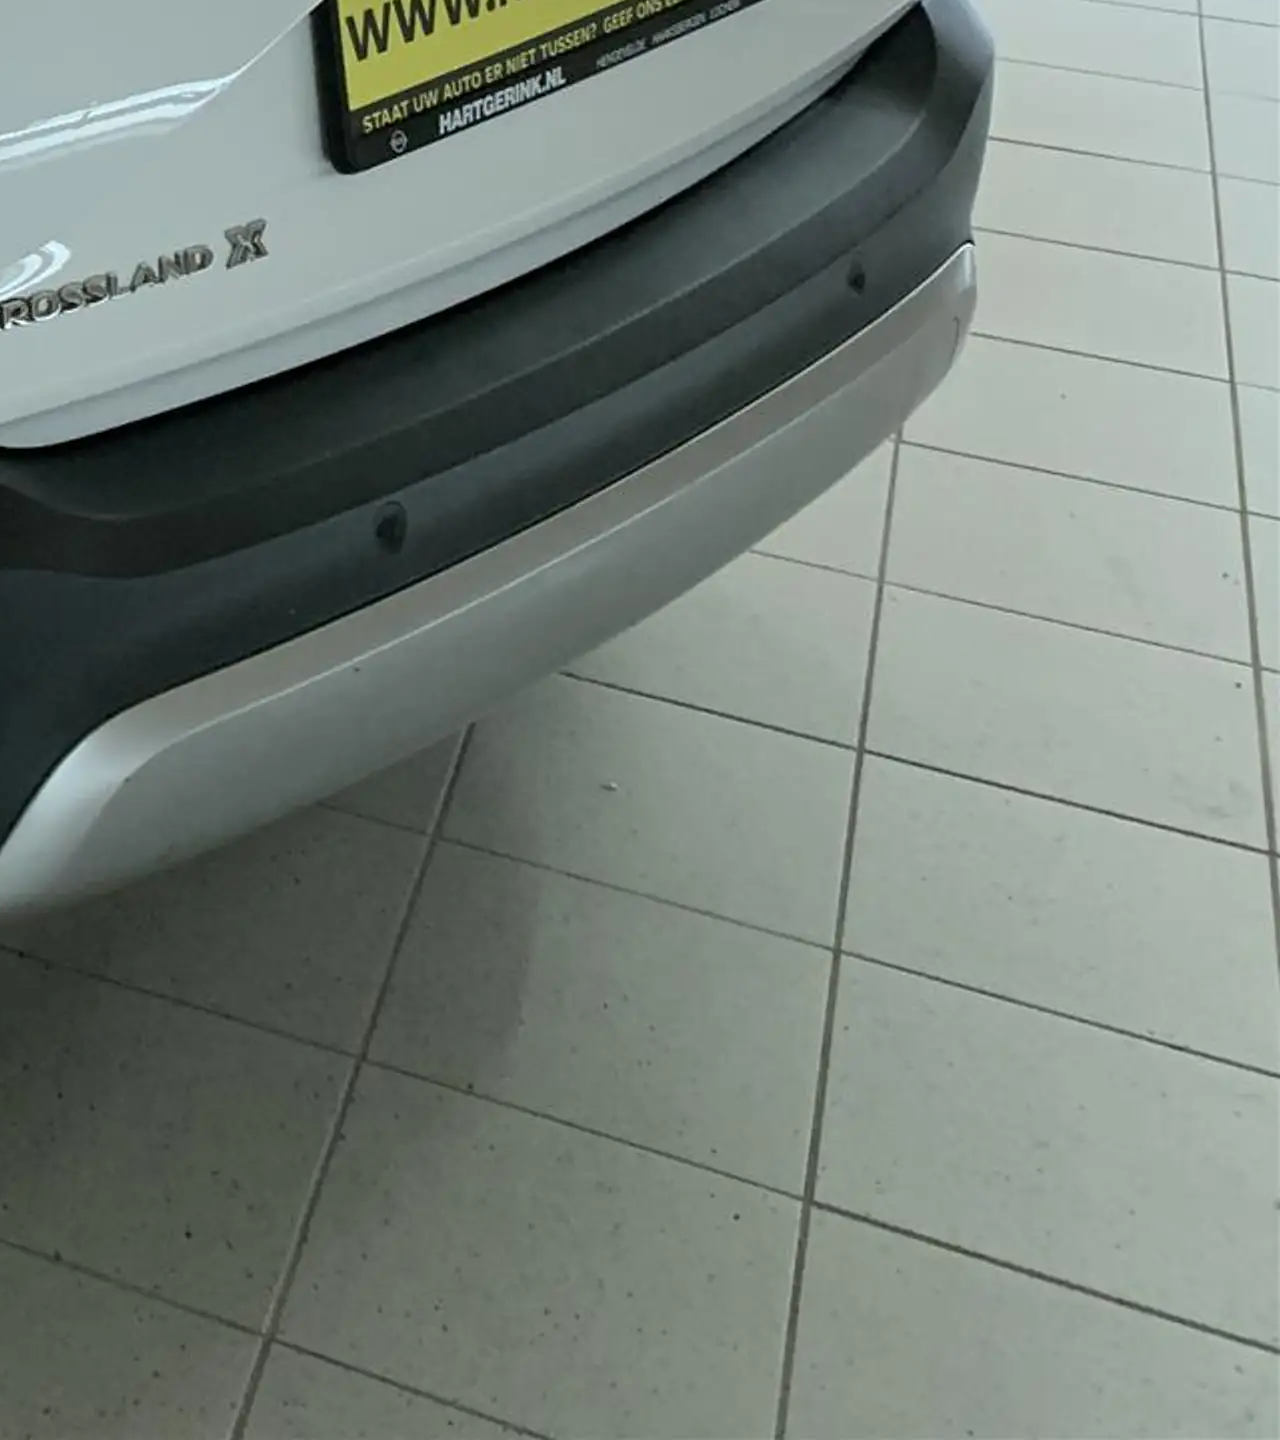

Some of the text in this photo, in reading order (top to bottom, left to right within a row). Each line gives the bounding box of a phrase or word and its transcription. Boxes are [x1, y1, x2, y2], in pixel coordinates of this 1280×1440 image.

[361, 101, 409, 135] STAAT
[412, 89, 440, 114] UW
[442, 72, 482, 104] AUTO
[484, 62, 505, 83] ER
[505, 47, 537, 76] NIET
[539, 22, 598, 60] TUSSEN?
[602, 6, 634, 34] GEEF
[438, 65, 568, 136] HARTGERINK.NL
[223, 217, 269, 270] X
